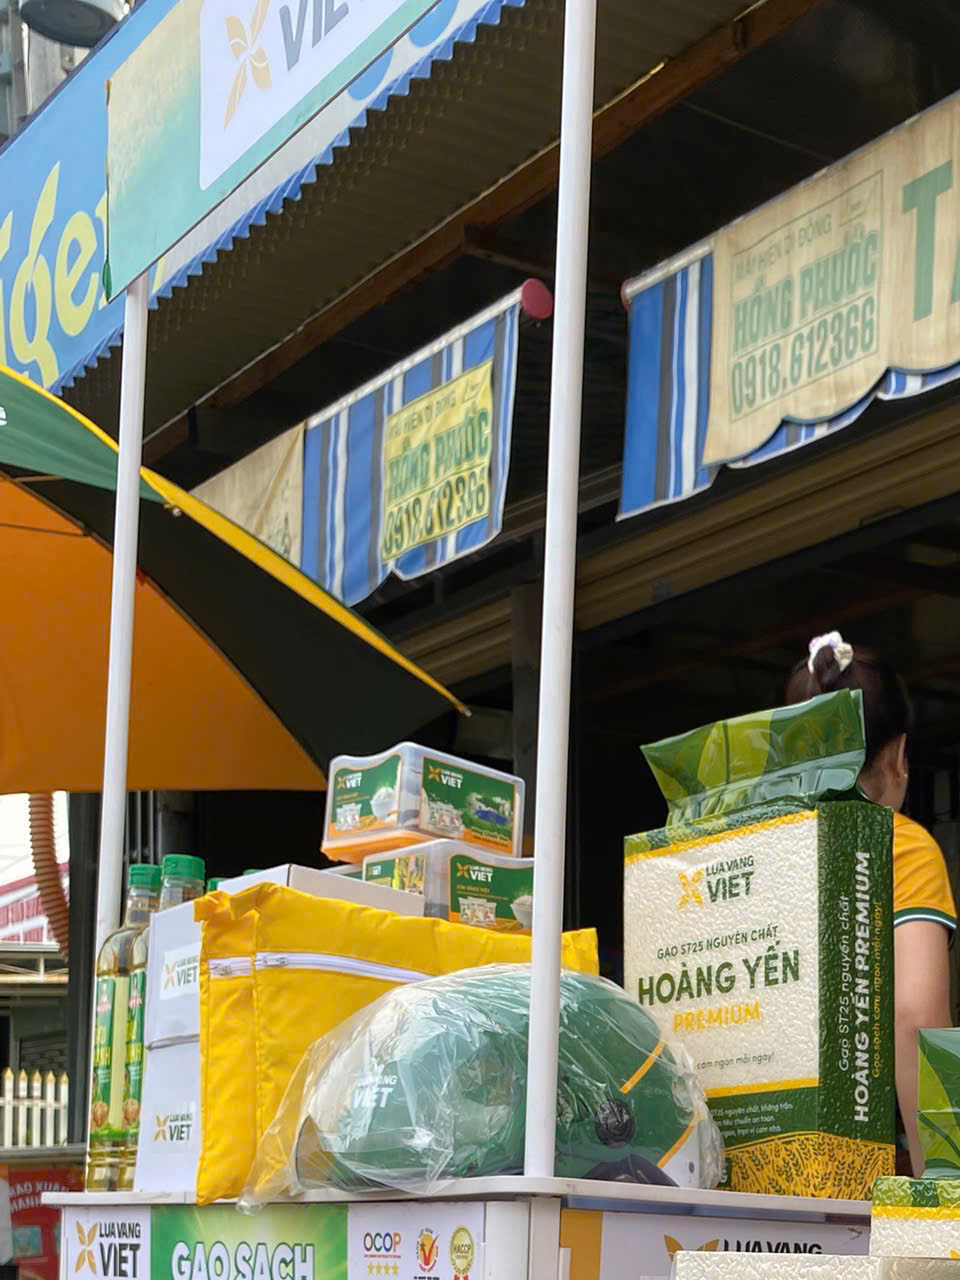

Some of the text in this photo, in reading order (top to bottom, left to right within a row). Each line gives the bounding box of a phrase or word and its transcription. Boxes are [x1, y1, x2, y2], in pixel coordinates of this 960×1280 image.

[732, 296, 875, 414] 0918.612366
[855, 852, 870, 971] PREMIUM
[638, 940, 800, 1007] HOÀNG YẾN
[673, 1001, 760, 1033] PREMIUM
[99, 1243, 141, 1279] VIET
[363, 1232, 401, 1252] OCOP
